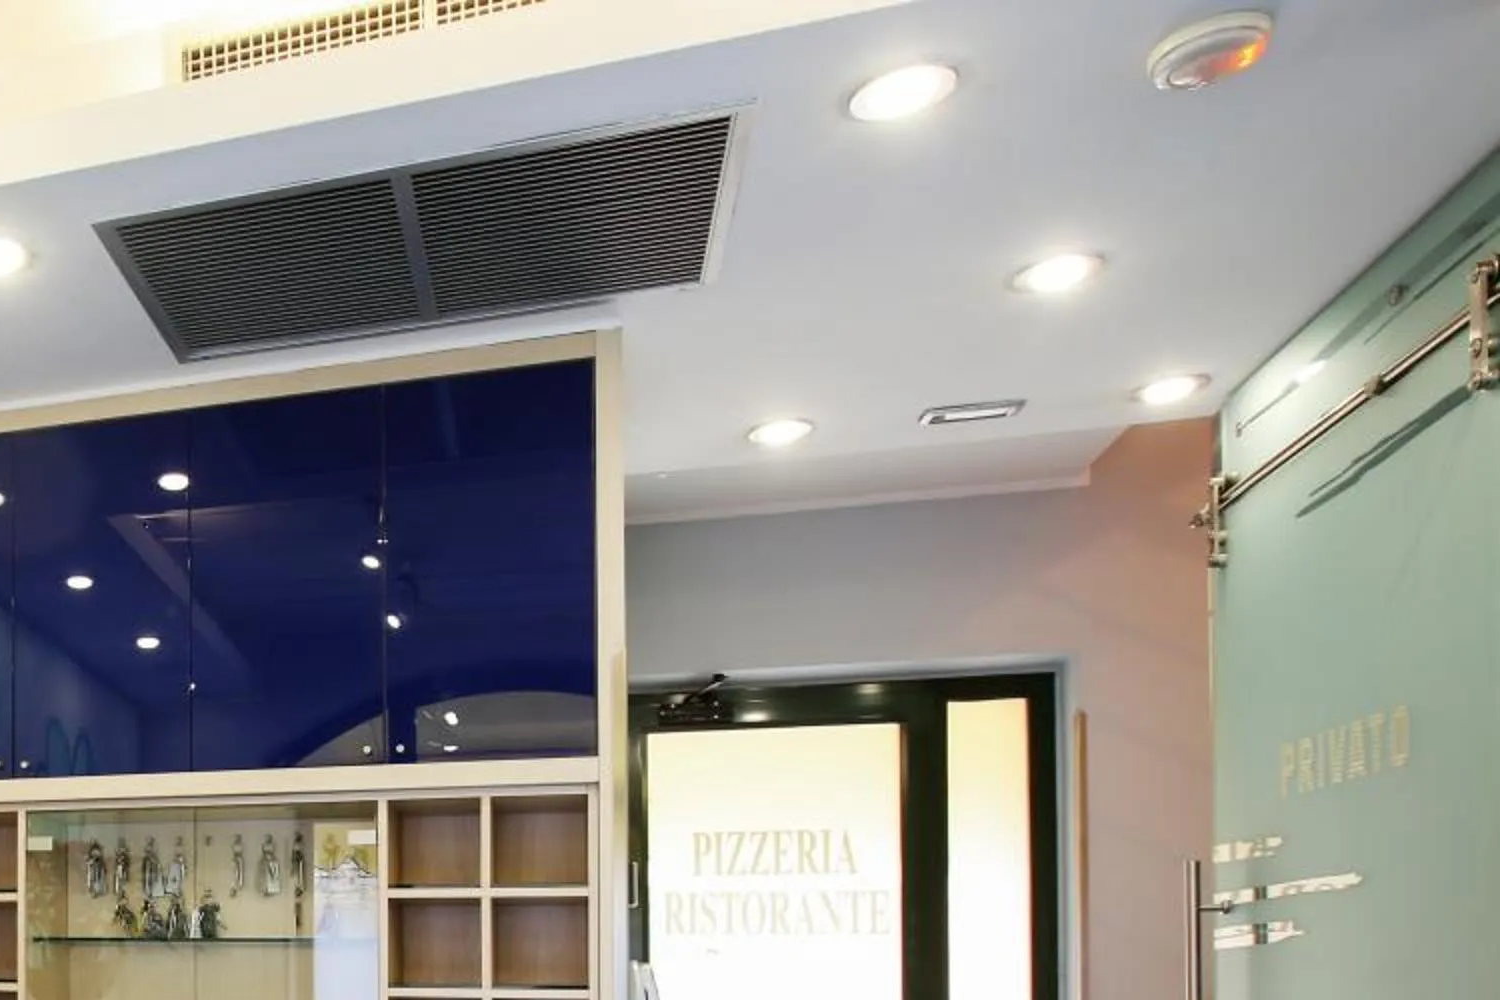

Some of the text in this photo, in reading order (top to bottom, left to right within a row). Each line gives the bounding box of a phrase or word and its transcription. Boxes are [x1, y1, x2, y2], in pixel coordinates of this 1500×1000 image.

[1280, 703, 1410, 800] PRIVATO
[690, 829, 858, 877] PIZZERIA
[664, 890, 891, 937] RISTORANTE
